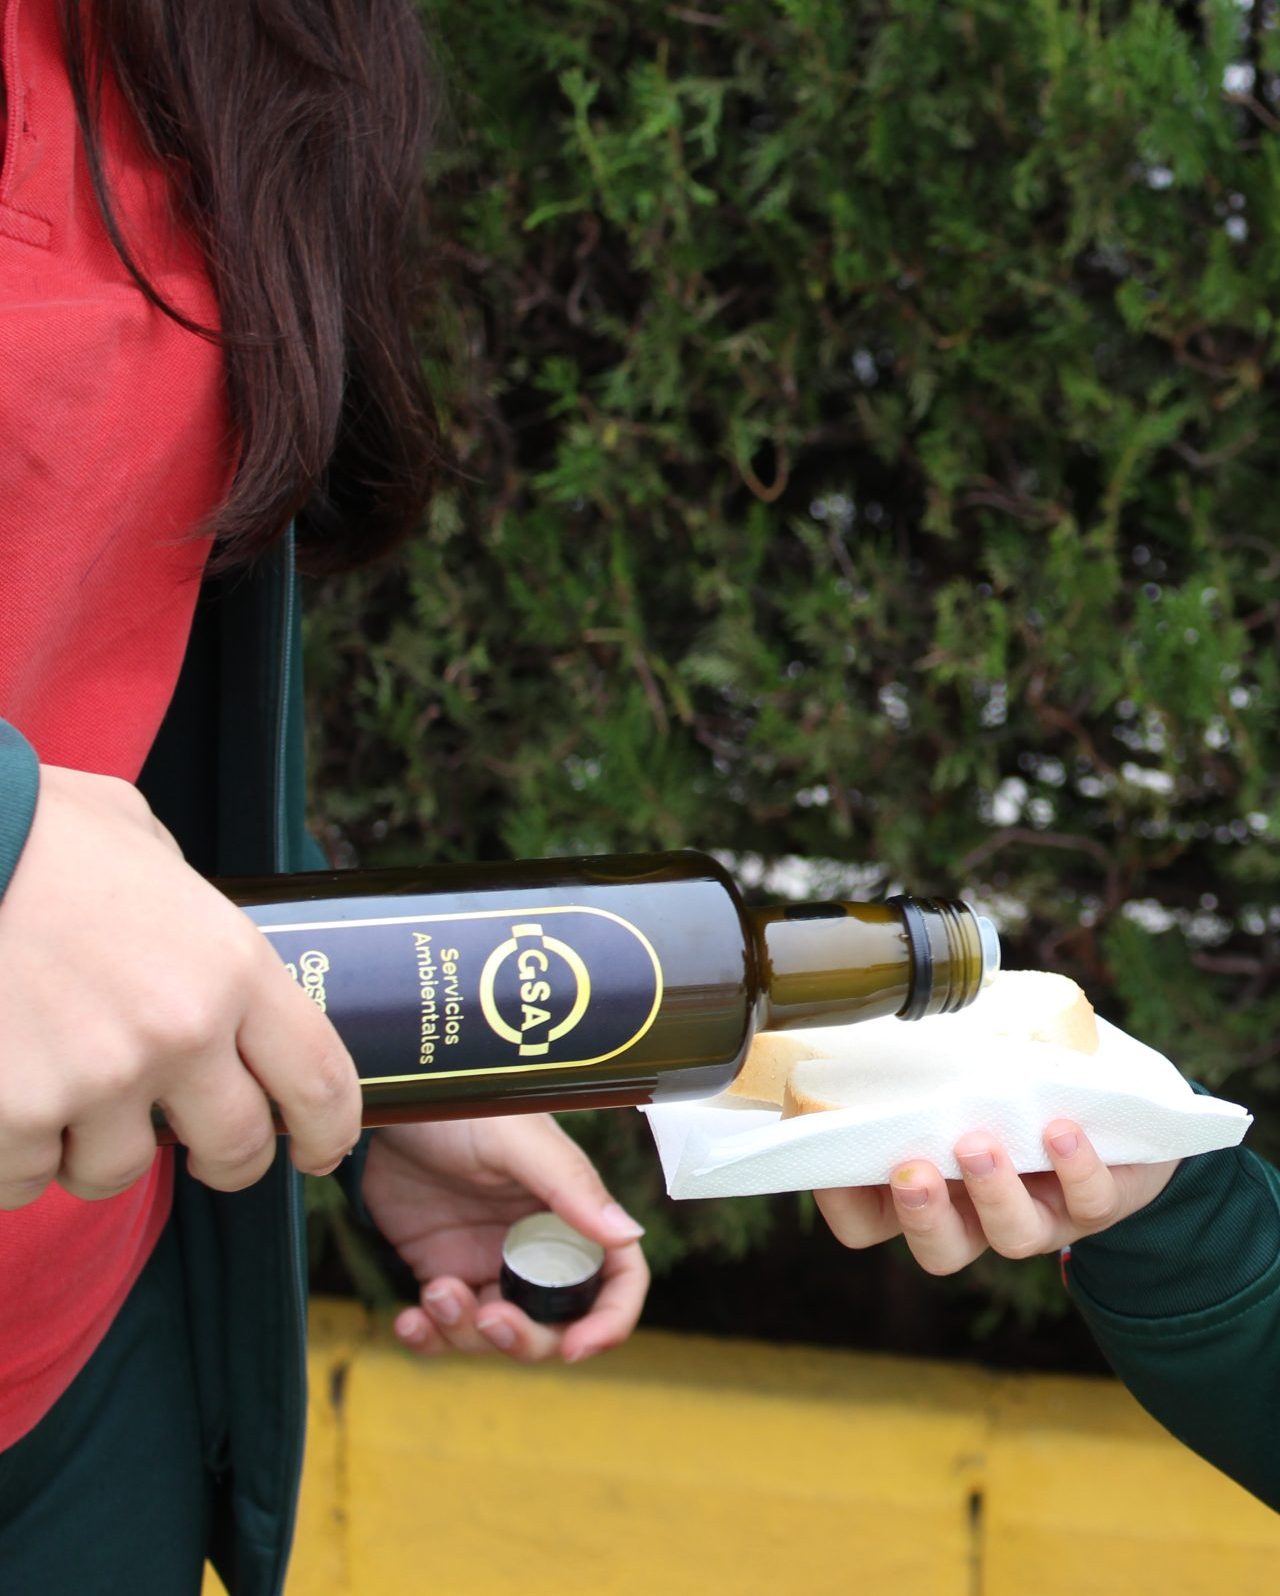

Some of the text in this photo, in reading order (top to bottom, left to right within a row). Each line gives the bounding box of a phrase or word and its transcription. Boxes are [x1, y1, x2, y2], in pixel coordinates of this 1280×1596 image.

[412, 932, 440, 1065] Ambientales
[440, 947, 464, 1046] Servicios
[517, 949, 552, 1032] GSA
